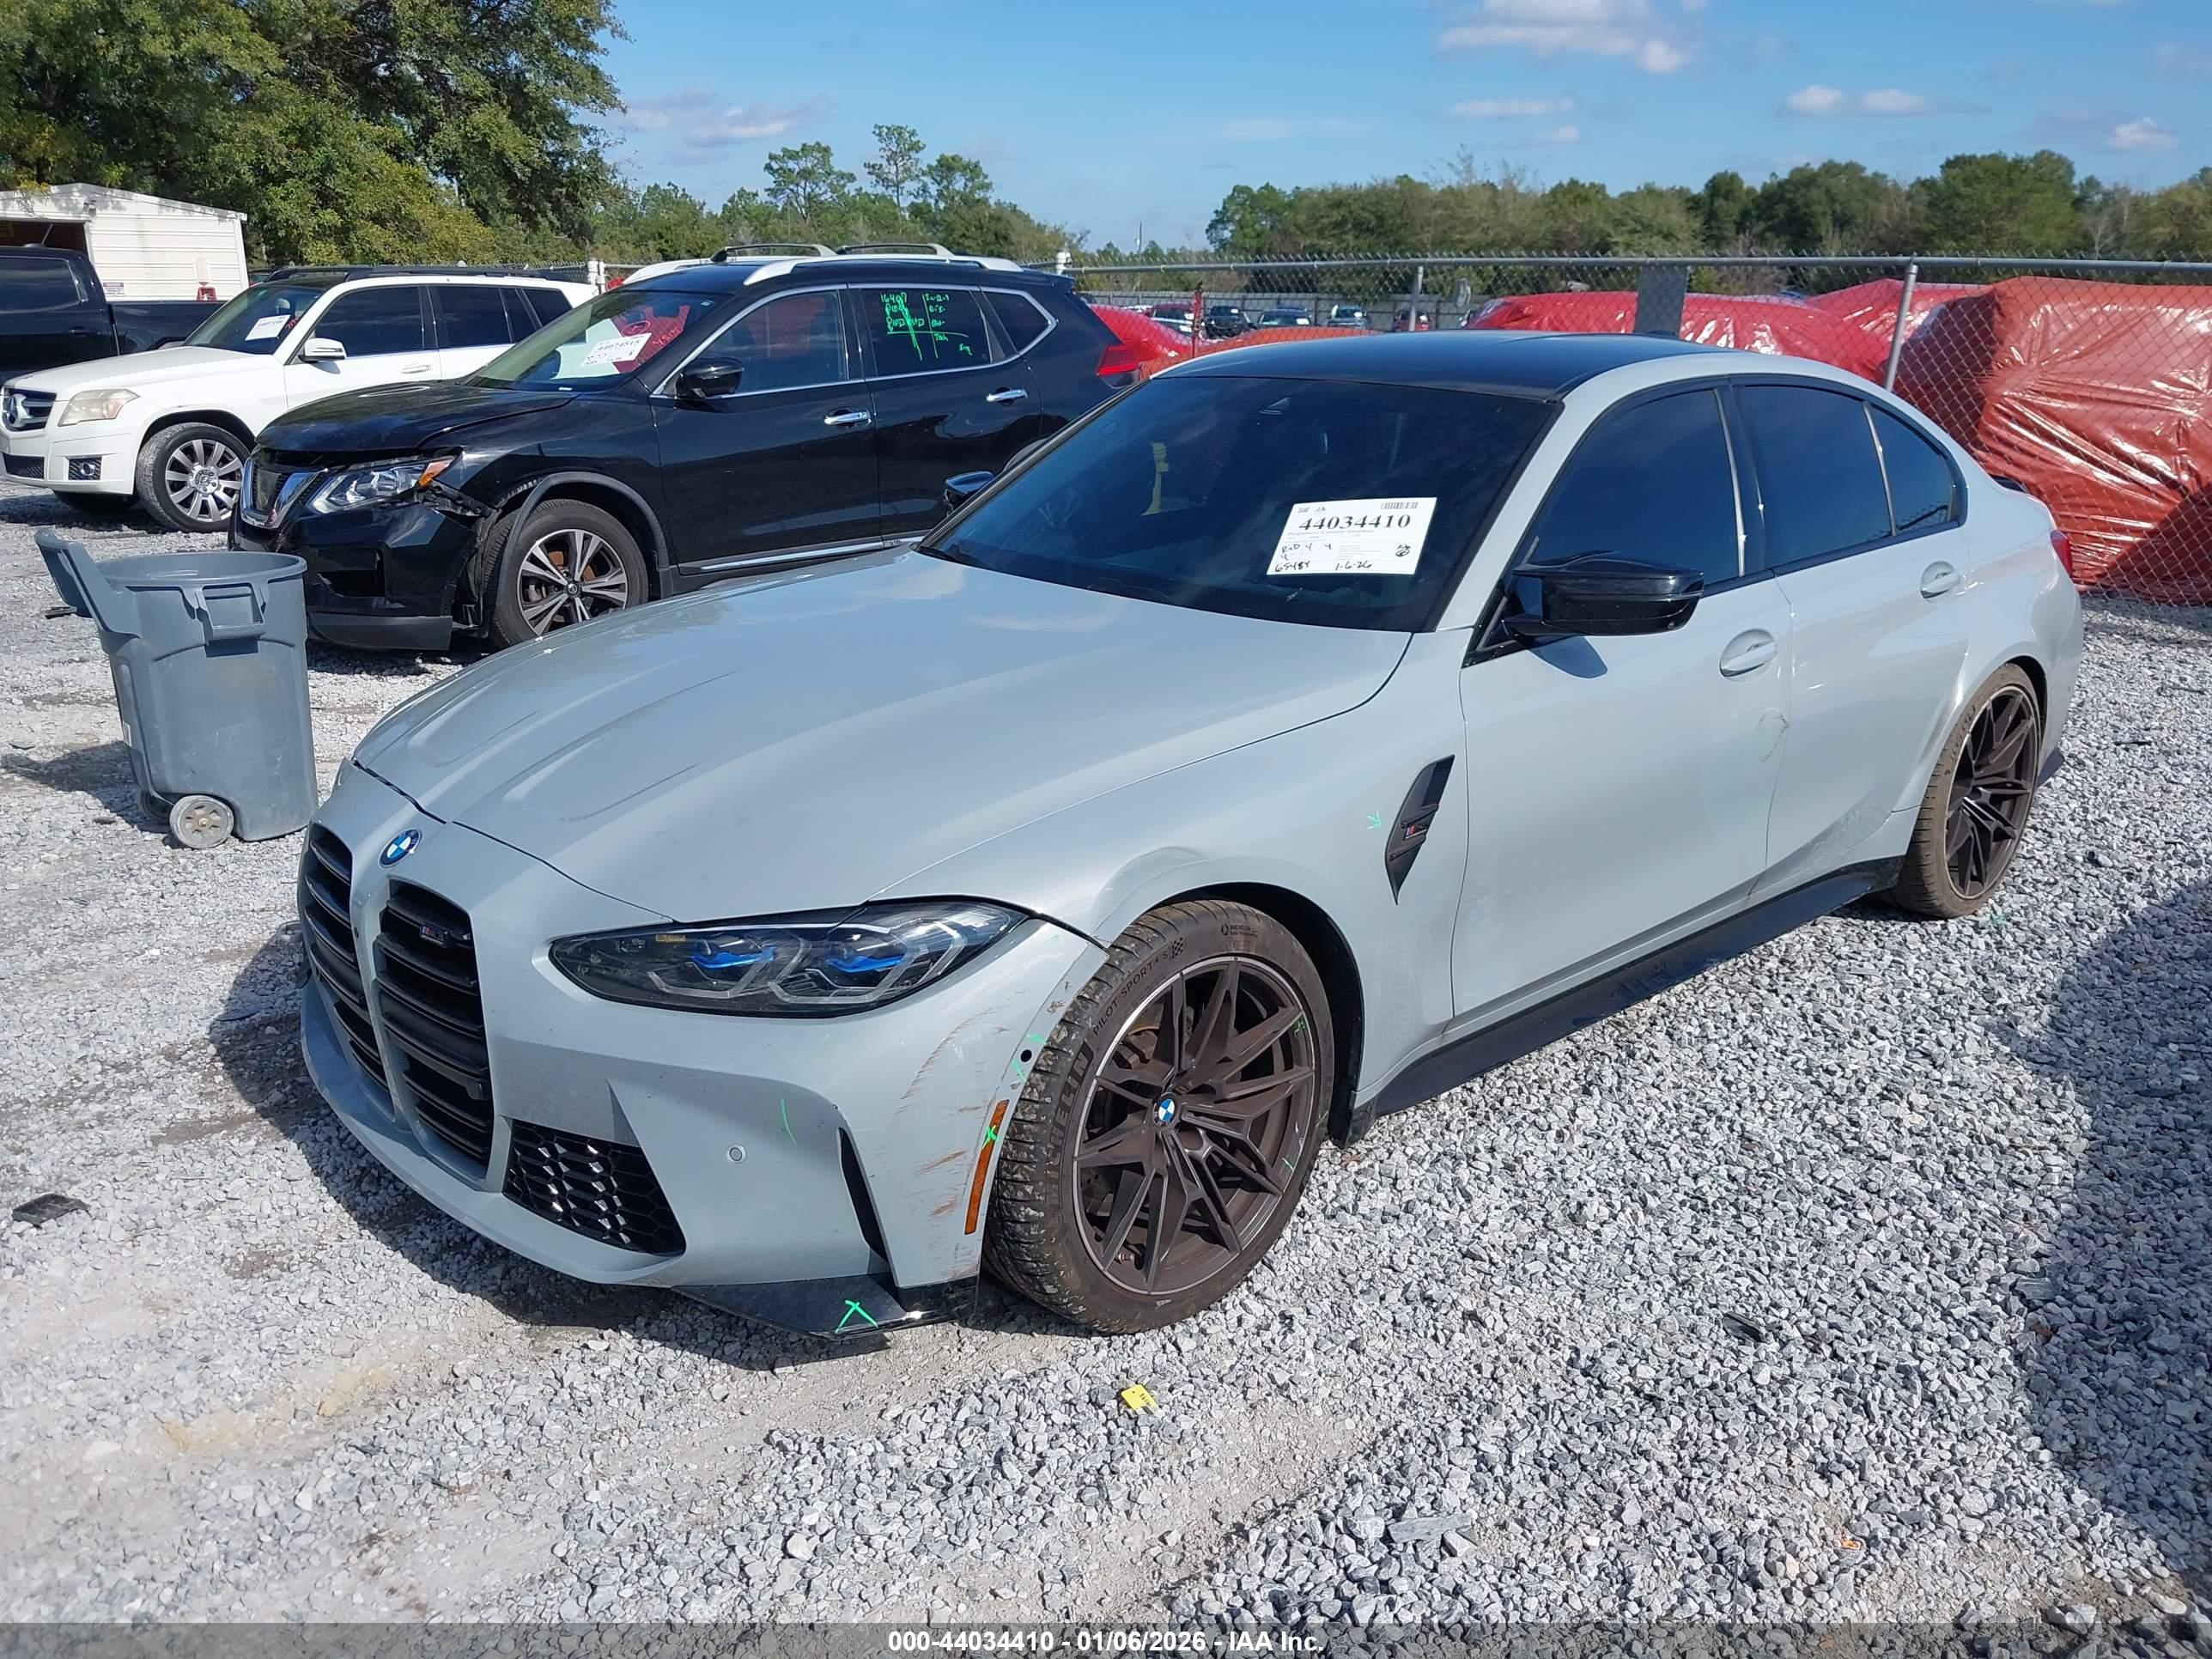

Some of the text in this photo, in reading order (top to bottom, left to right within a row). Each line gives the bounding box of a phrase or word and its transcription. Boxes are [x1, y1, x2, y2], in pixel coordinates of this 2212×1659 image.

[1298, 514, 1411, 531] 44034410
[1092, 997, 1119, 1036] PILOT
[1121, 961, 1155, 998] SPORT
